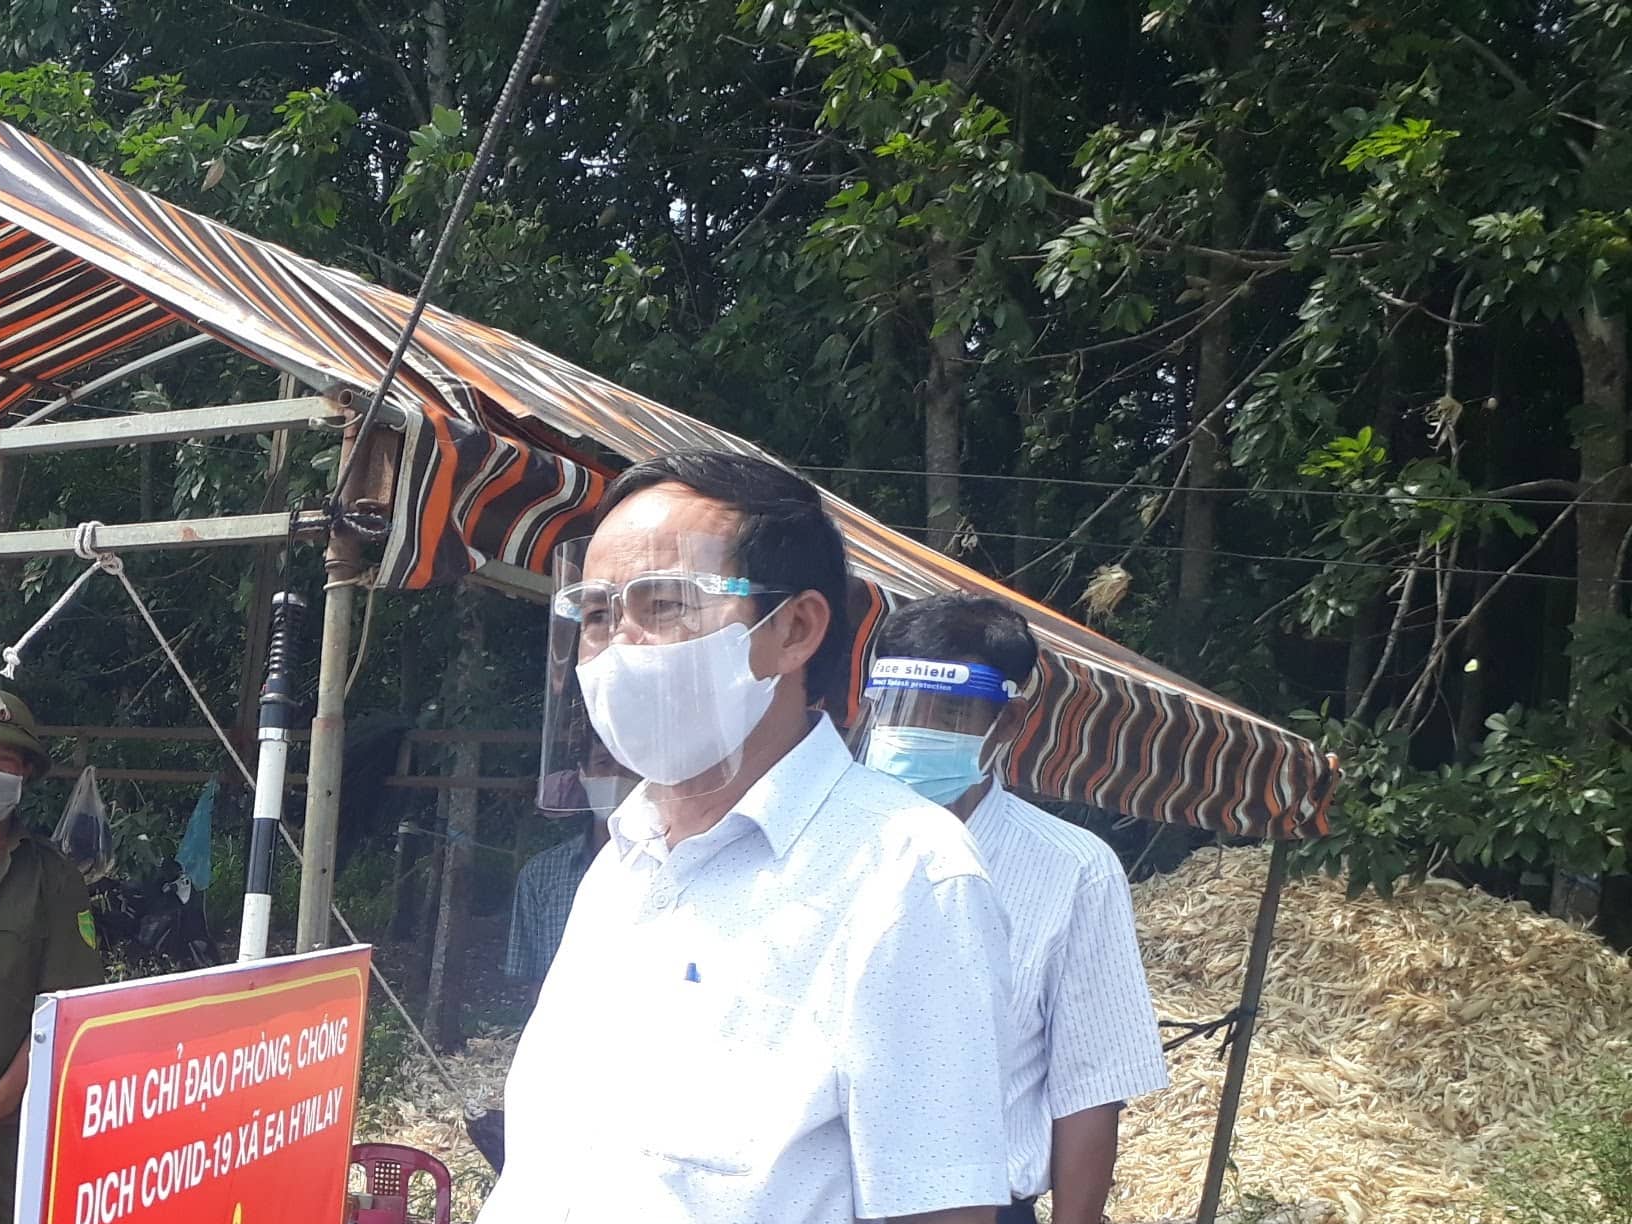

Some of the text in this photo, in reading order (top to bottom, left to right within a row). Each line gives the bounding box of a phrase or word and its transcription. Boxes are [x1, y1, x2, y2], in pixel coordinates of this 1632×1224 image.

[905, 663, 957, 679] shield
[910, 680, 952, 691] protection
[82, 1011, 348, 1138] BAN CHỈ ĐẠO PHÒNG, CHỐNG
[141, 1131, 233, 1208] COVID-19
[235, 1109, 261, 1169] XÃ
[263, 1110, 285, 1156] EA
[288, 1086, 343, 1145] H'MLAY
